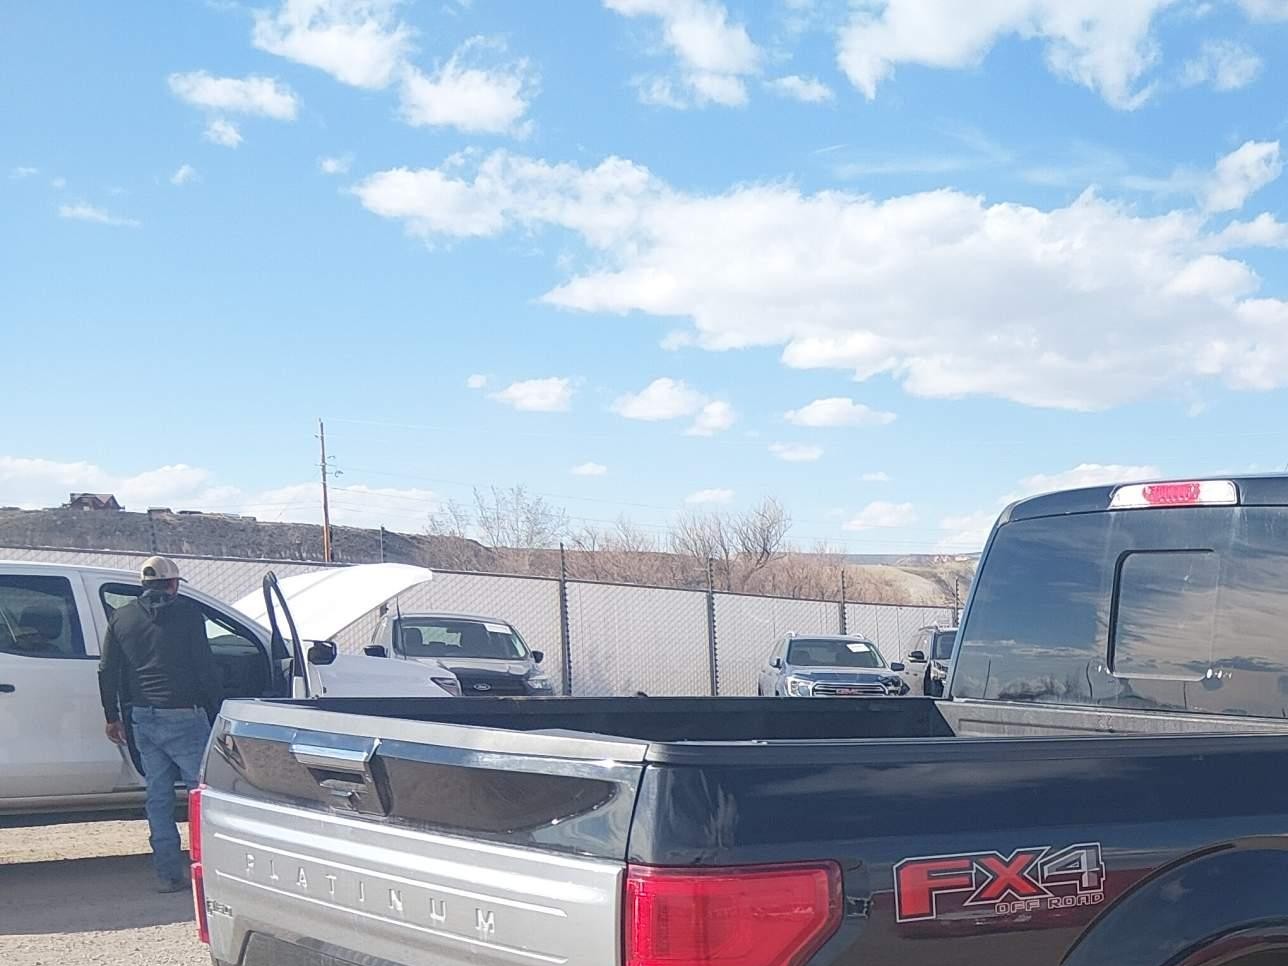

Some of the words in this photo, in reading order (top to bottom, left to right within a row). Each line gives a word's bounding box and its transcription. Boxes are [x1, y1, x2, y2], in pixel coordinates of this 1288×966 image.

[245, 852, 496, 934] PLATINUM
[893, 842, 1105, 922] FX4
[994, 899, 1041, 915] OFF
[1047, 892, 1105, 910] ROAD
